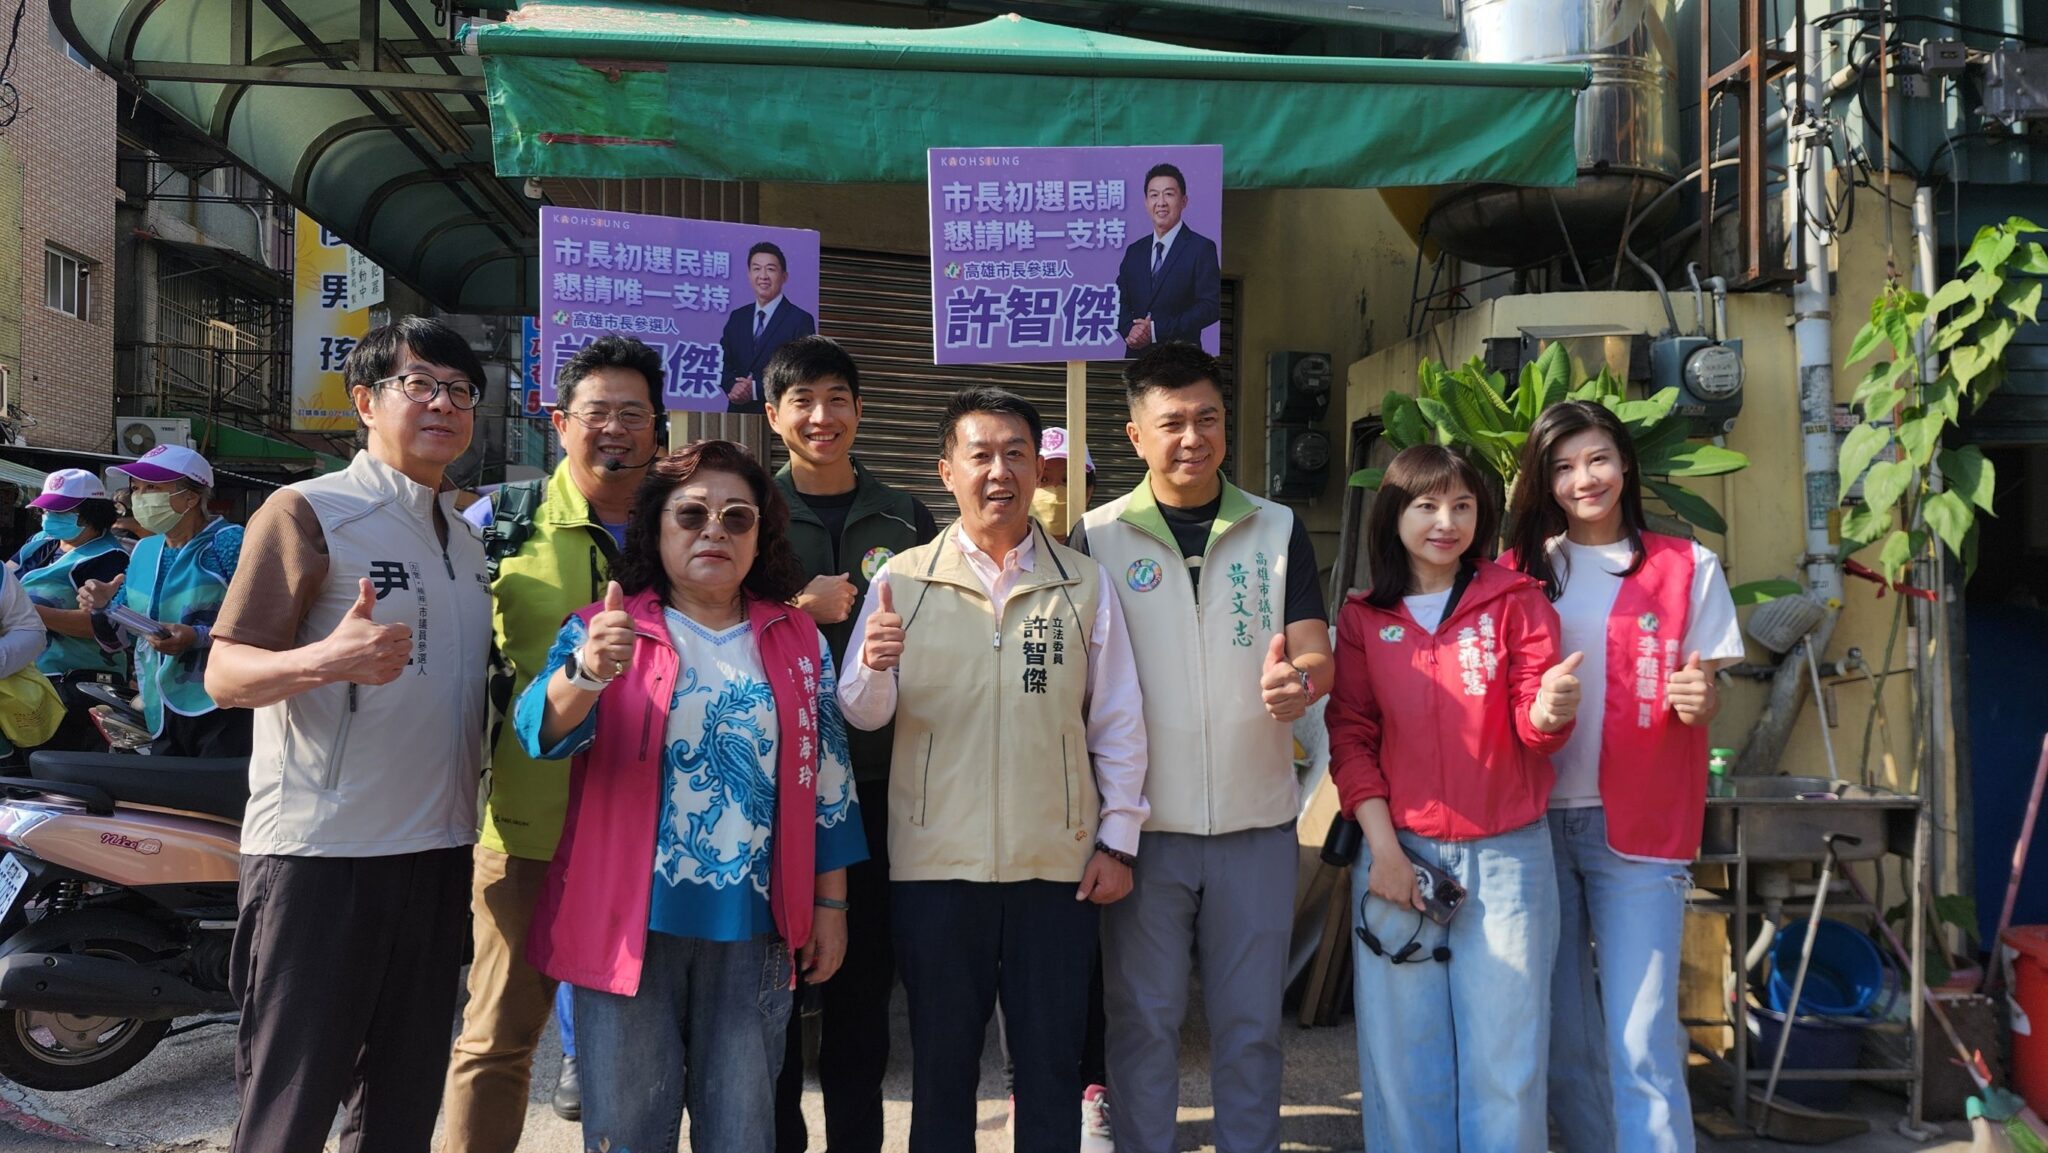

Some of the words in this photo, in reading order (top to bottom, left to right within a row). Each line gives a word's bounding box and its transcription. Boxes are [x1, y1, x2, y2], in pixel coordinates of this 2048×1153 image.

[940, 155, 1020, 167] KAOHSIUNG
[942, 179, 1126, 214] 市長初選民調
[552, 213, 631, 230] KAOHSIUNG
[943, 218, 1126, 251] 懇請唯一支持
[553, 237, 731, 279] 市長初選民調
[964, 259, 1074, 280] 高雄市長參選人
[552, 272, 731, 313] 懇請唯一支持
[572, 311, 680, 335] 高雄市長參選人
[945, 283, 1122, 349] 許智傑
[551, 333, 725, 399] 許傑
[1227, 563, 1254, 647] 黃文志
[1255, 551, 1273, 631] 高雄市議員
[1022, 615, 1048, 694] 許智傑
[1053, 616, 1064, 665] 立法委員
[798, 707, 813, 789] 周海玲
